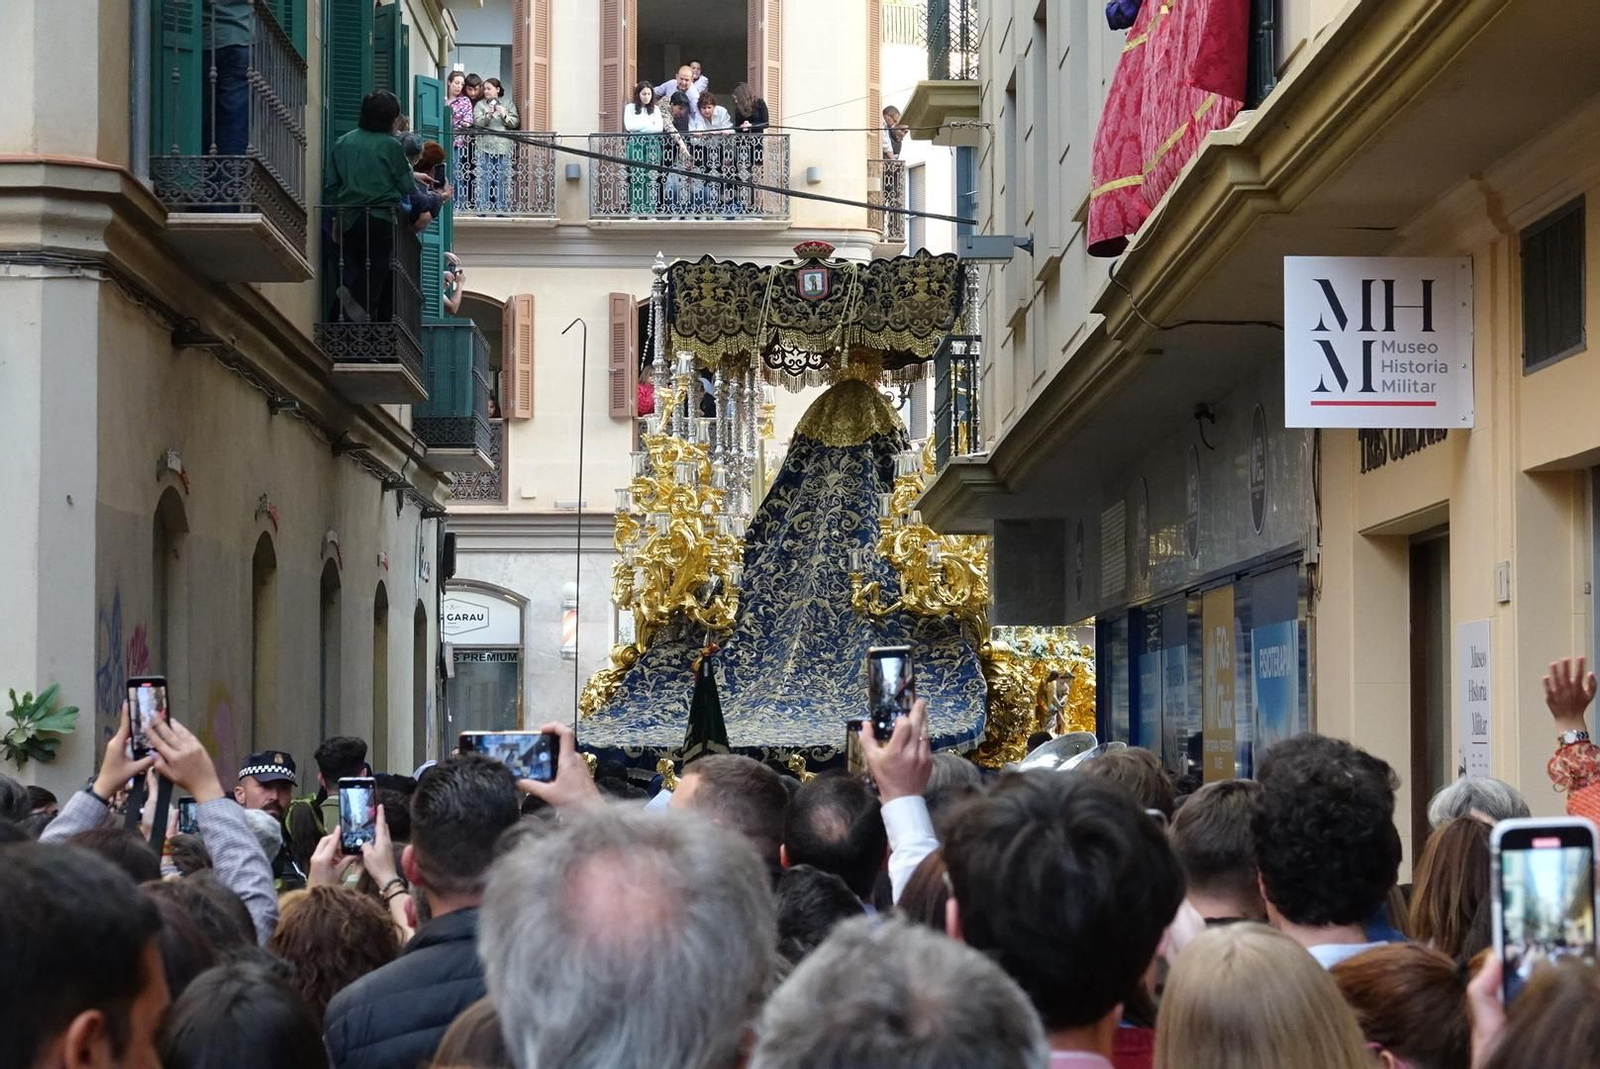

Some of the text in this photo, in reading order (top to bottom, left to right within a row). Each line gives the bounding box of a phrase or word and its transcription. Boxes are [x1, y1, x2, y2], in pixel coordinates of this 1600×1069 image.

[1381, 340, 1439, 354] Museo
[1310, 340, 1378, 393] M
[1381, 359, 1449, 374] Historia
[1381, 379, 1437, 393] Militar
[446, 613, 484, 621] GARAU
[463, 653, 517, 662] PREMIUM
[1470, 645, 1487, 668] Museo
[1468, 680, 1487, 702] Historia
[1471, 712, 1488, 735] Militar
